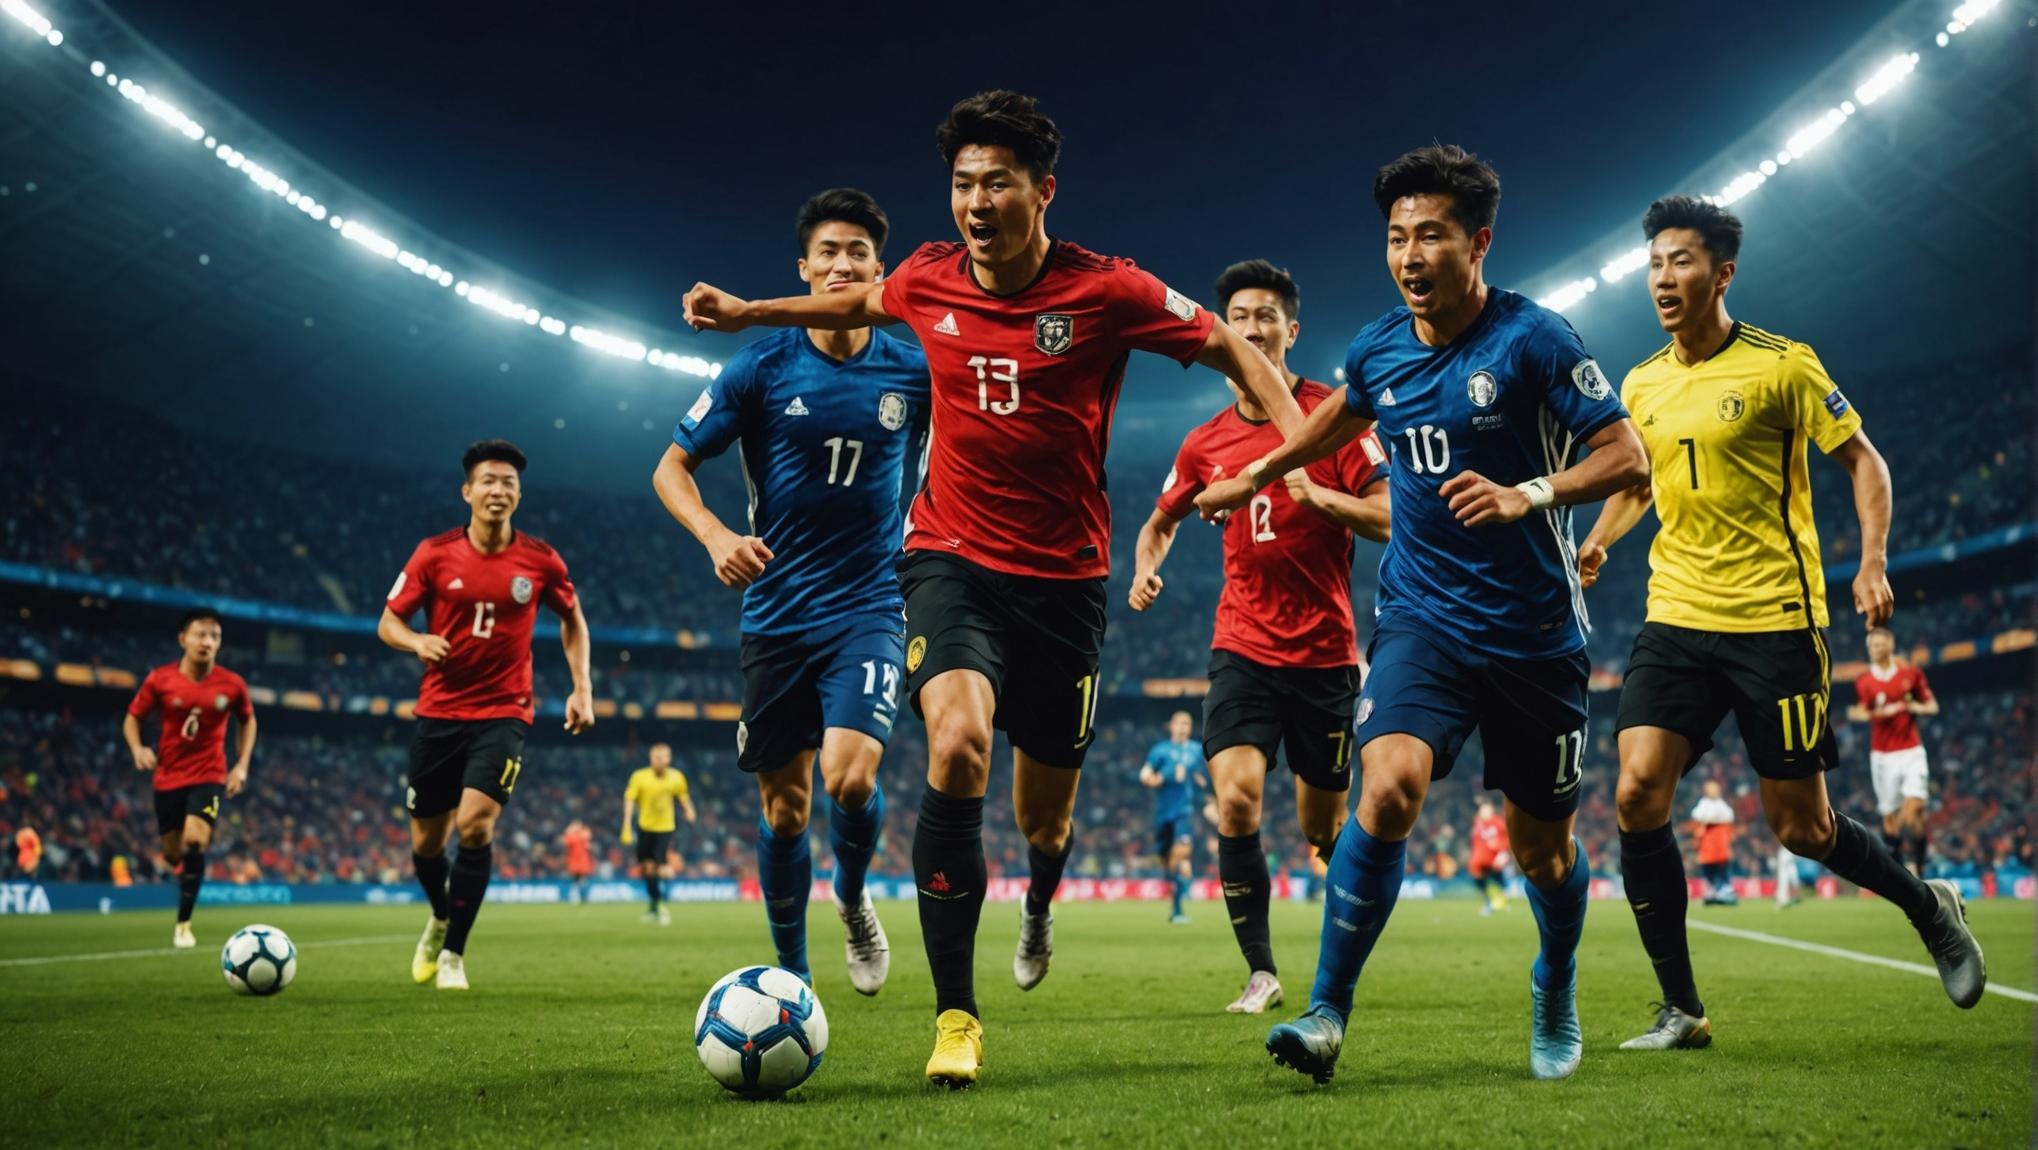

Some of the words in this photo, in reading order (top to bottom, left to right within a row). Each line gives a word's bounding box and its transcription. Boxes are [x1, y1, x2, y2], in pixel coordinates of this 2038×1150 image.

[966, 355, 1020, 416] 13
[823, 436, 864, 487] 17
[1404, 424, 1450, 475] 10
[1678, 438, 1699, 490] 1
